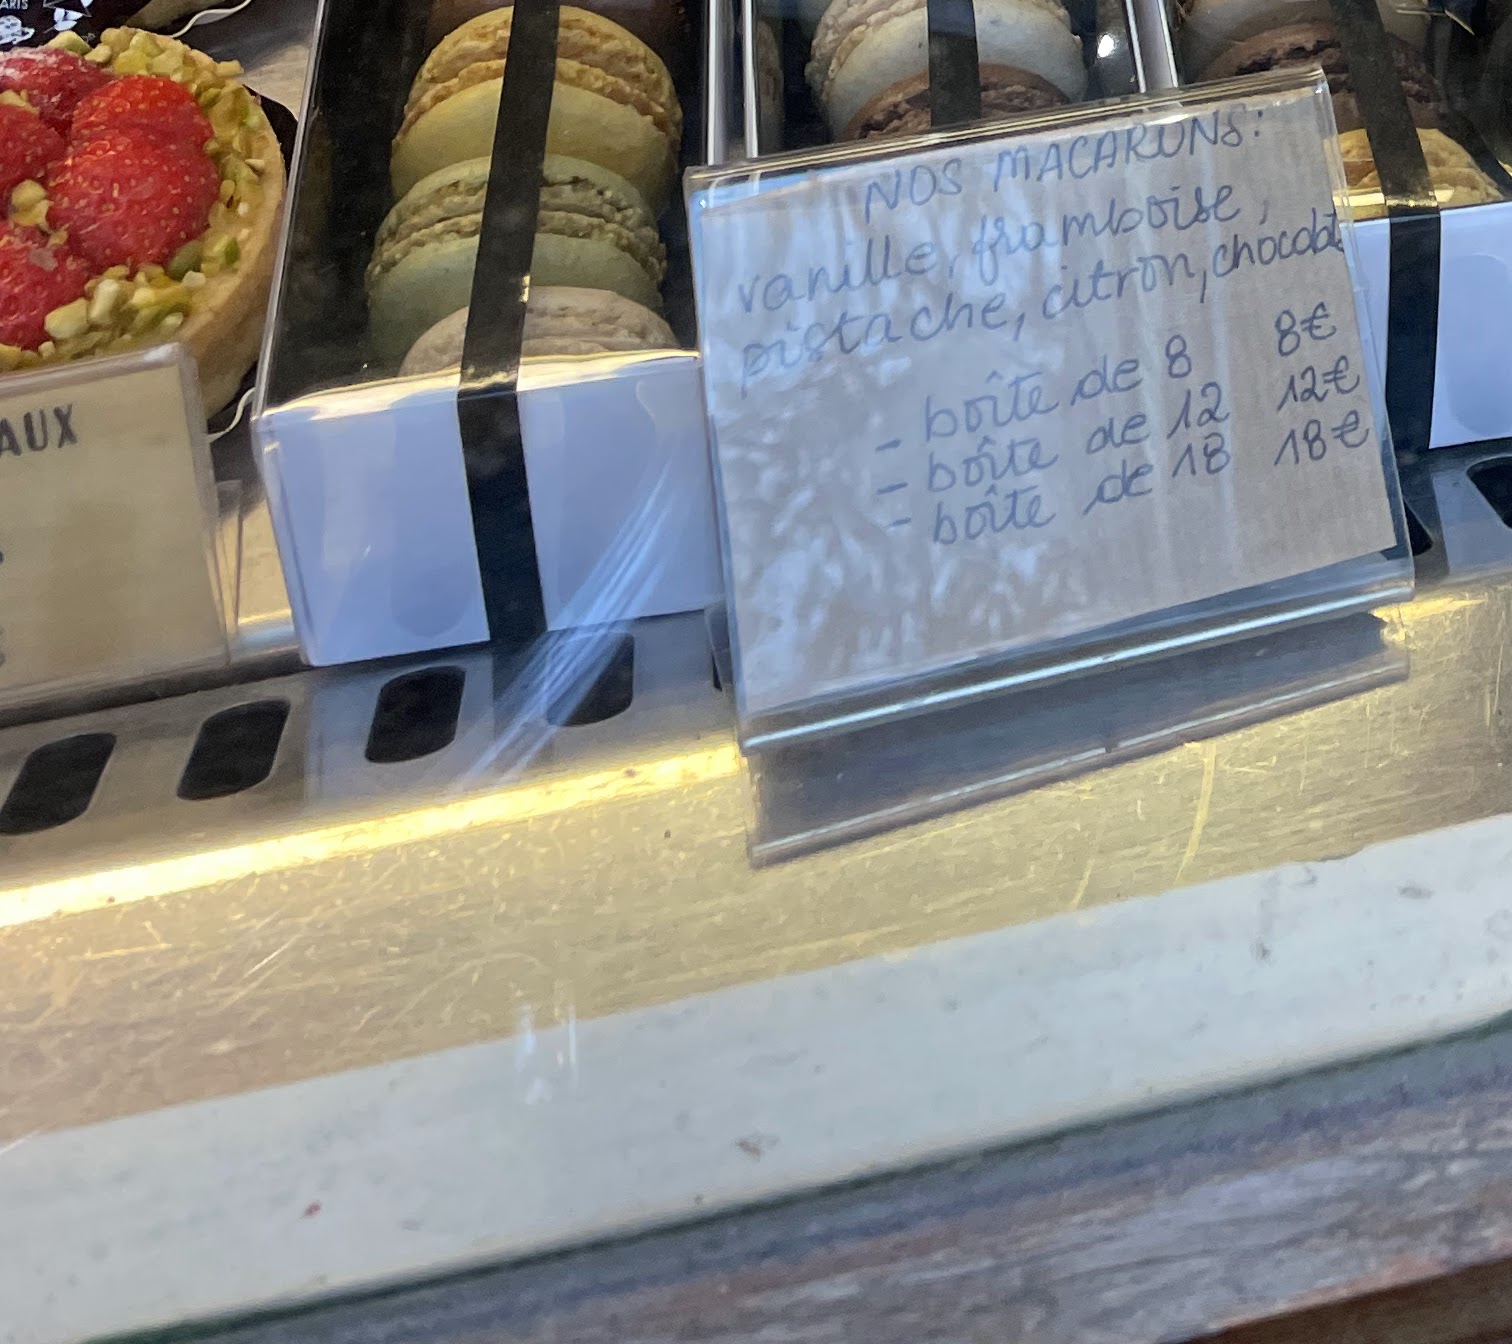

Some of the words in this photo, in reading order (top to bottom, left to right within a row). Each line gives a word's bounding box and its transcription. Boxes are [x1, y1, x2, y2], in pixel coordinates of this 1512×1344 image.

[865, 157, 963, 225] NOS
[925, 370, 1060, 443] boîte
[1070, 354, 1143, 407] de
[1165, 333, 1193, 379] 8
[1274, 301, 1337, 358] 8€
[927, 435, 1060, 493] boîte
[1085, 411, 1151, 455] de
[1165, 381, 1230, 441] 12
[1277, 355, 1362, 411] 12€
[932, 483, 1058, 546] boîte
[1082, 458, 1155, 516] de
[1171, 431, 1231, 478] 18
[1274, 410, 1370, 467] 18€
